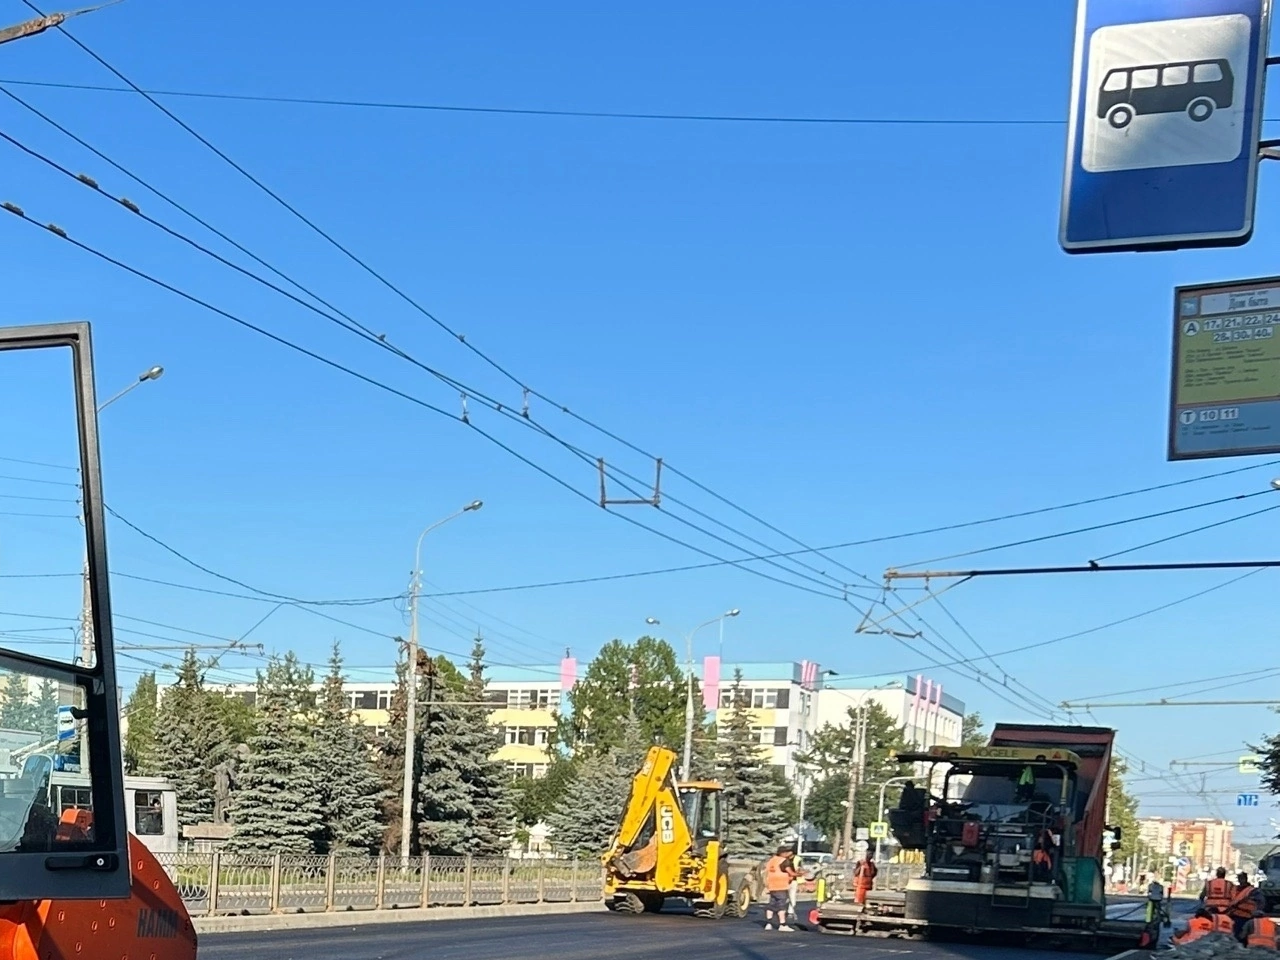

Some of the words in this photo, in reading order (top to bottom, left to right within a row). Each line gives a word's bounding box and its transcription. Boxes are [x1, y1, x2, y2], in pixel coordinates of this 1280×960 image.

[1202, 411, 1216, 420] 10
[1224, 409, 1236, 418] 11
[661, 805, 674, 844] JCB
[137, 908, 179, 938] HAMM
